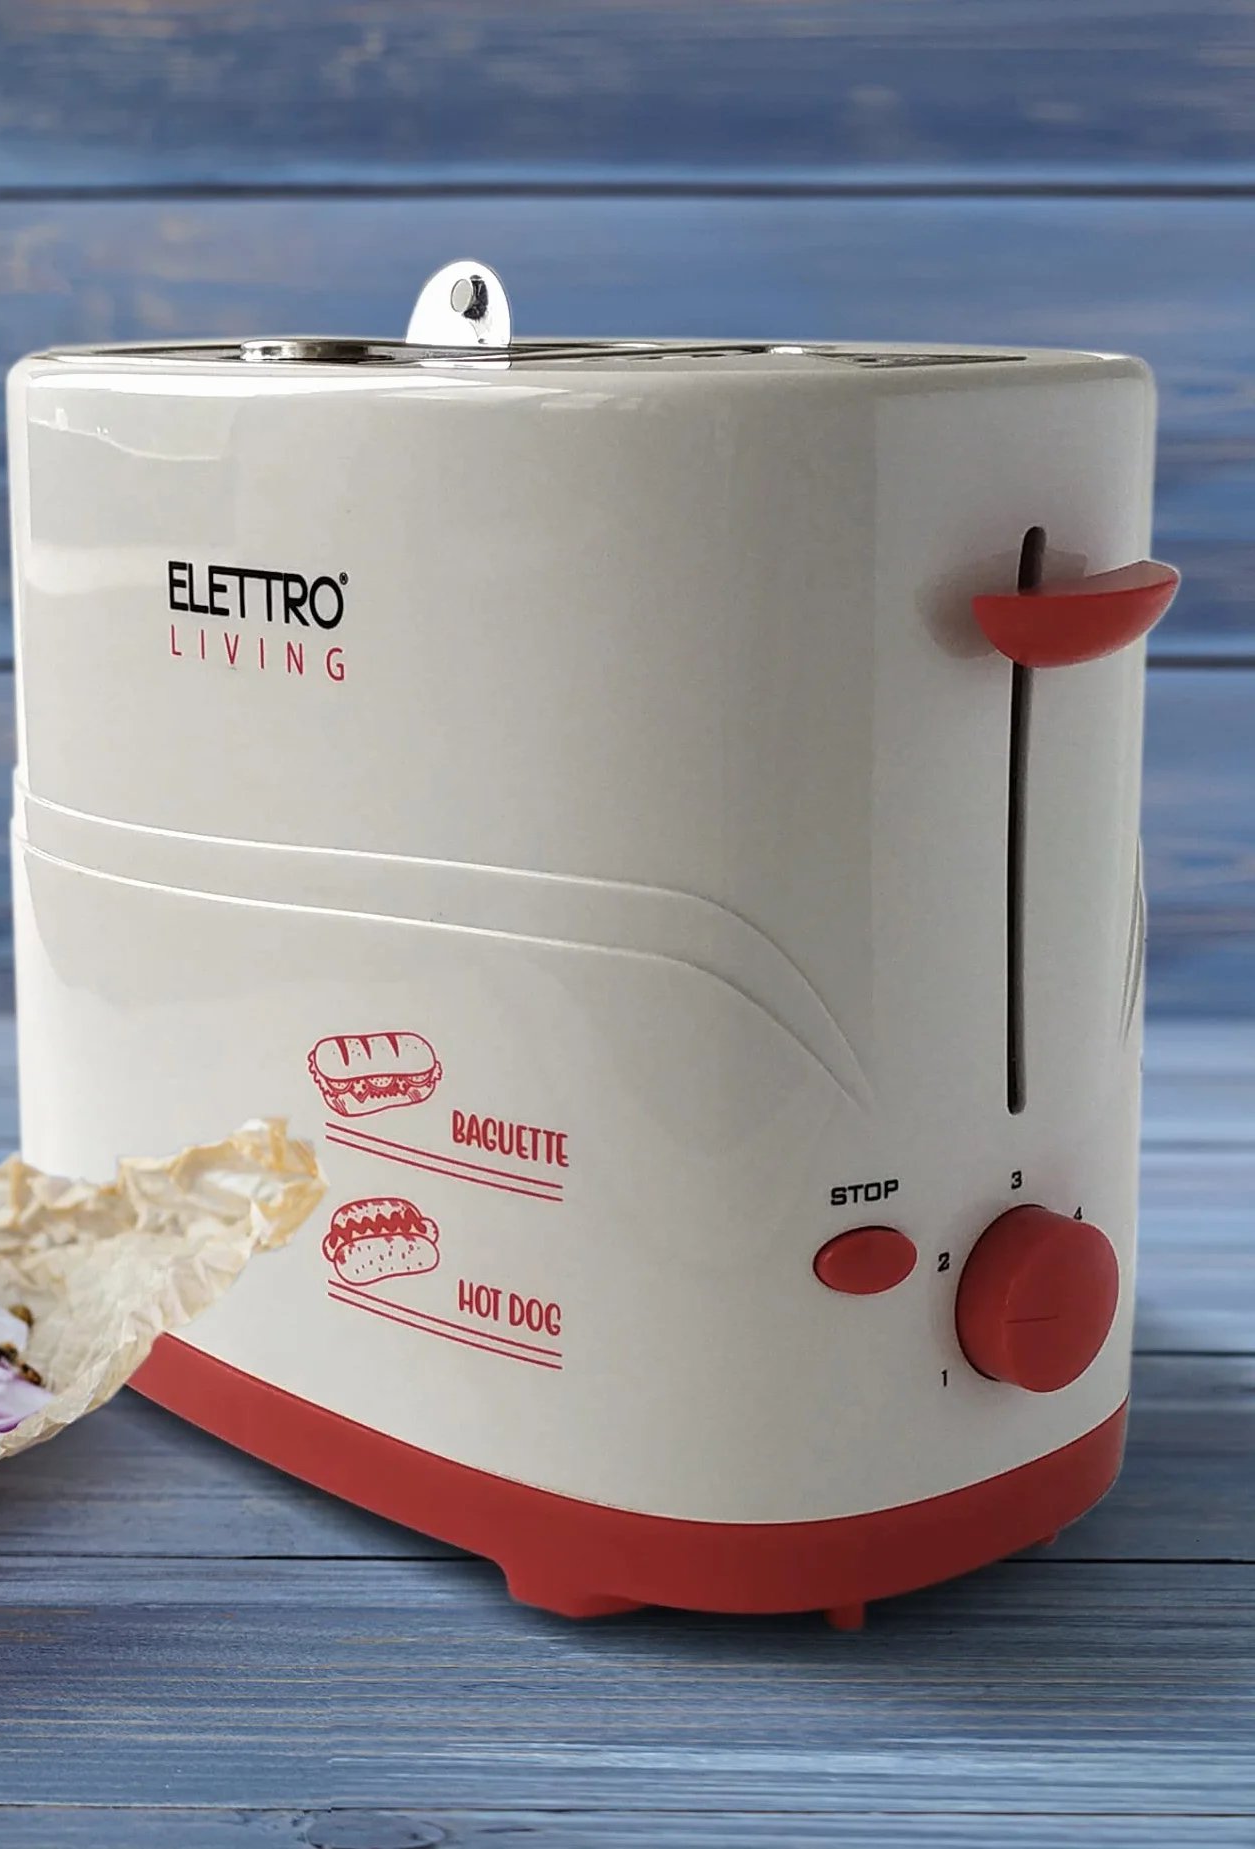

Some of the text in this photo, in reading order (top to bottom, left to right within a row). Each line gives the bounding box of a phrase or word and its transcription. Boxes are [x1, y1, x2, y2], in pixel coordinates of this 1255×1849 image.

[170, 623, 345, 681] LIVING
[452, 1109, 569, 1167] BAGUETTE
[830, 1179, 899, 1206] STOP
[1011, 1170, 1022, 1190] 3
[937, 1252, 950, 1272] 2
[458, 1278, 561, 1336] HOT DOG
